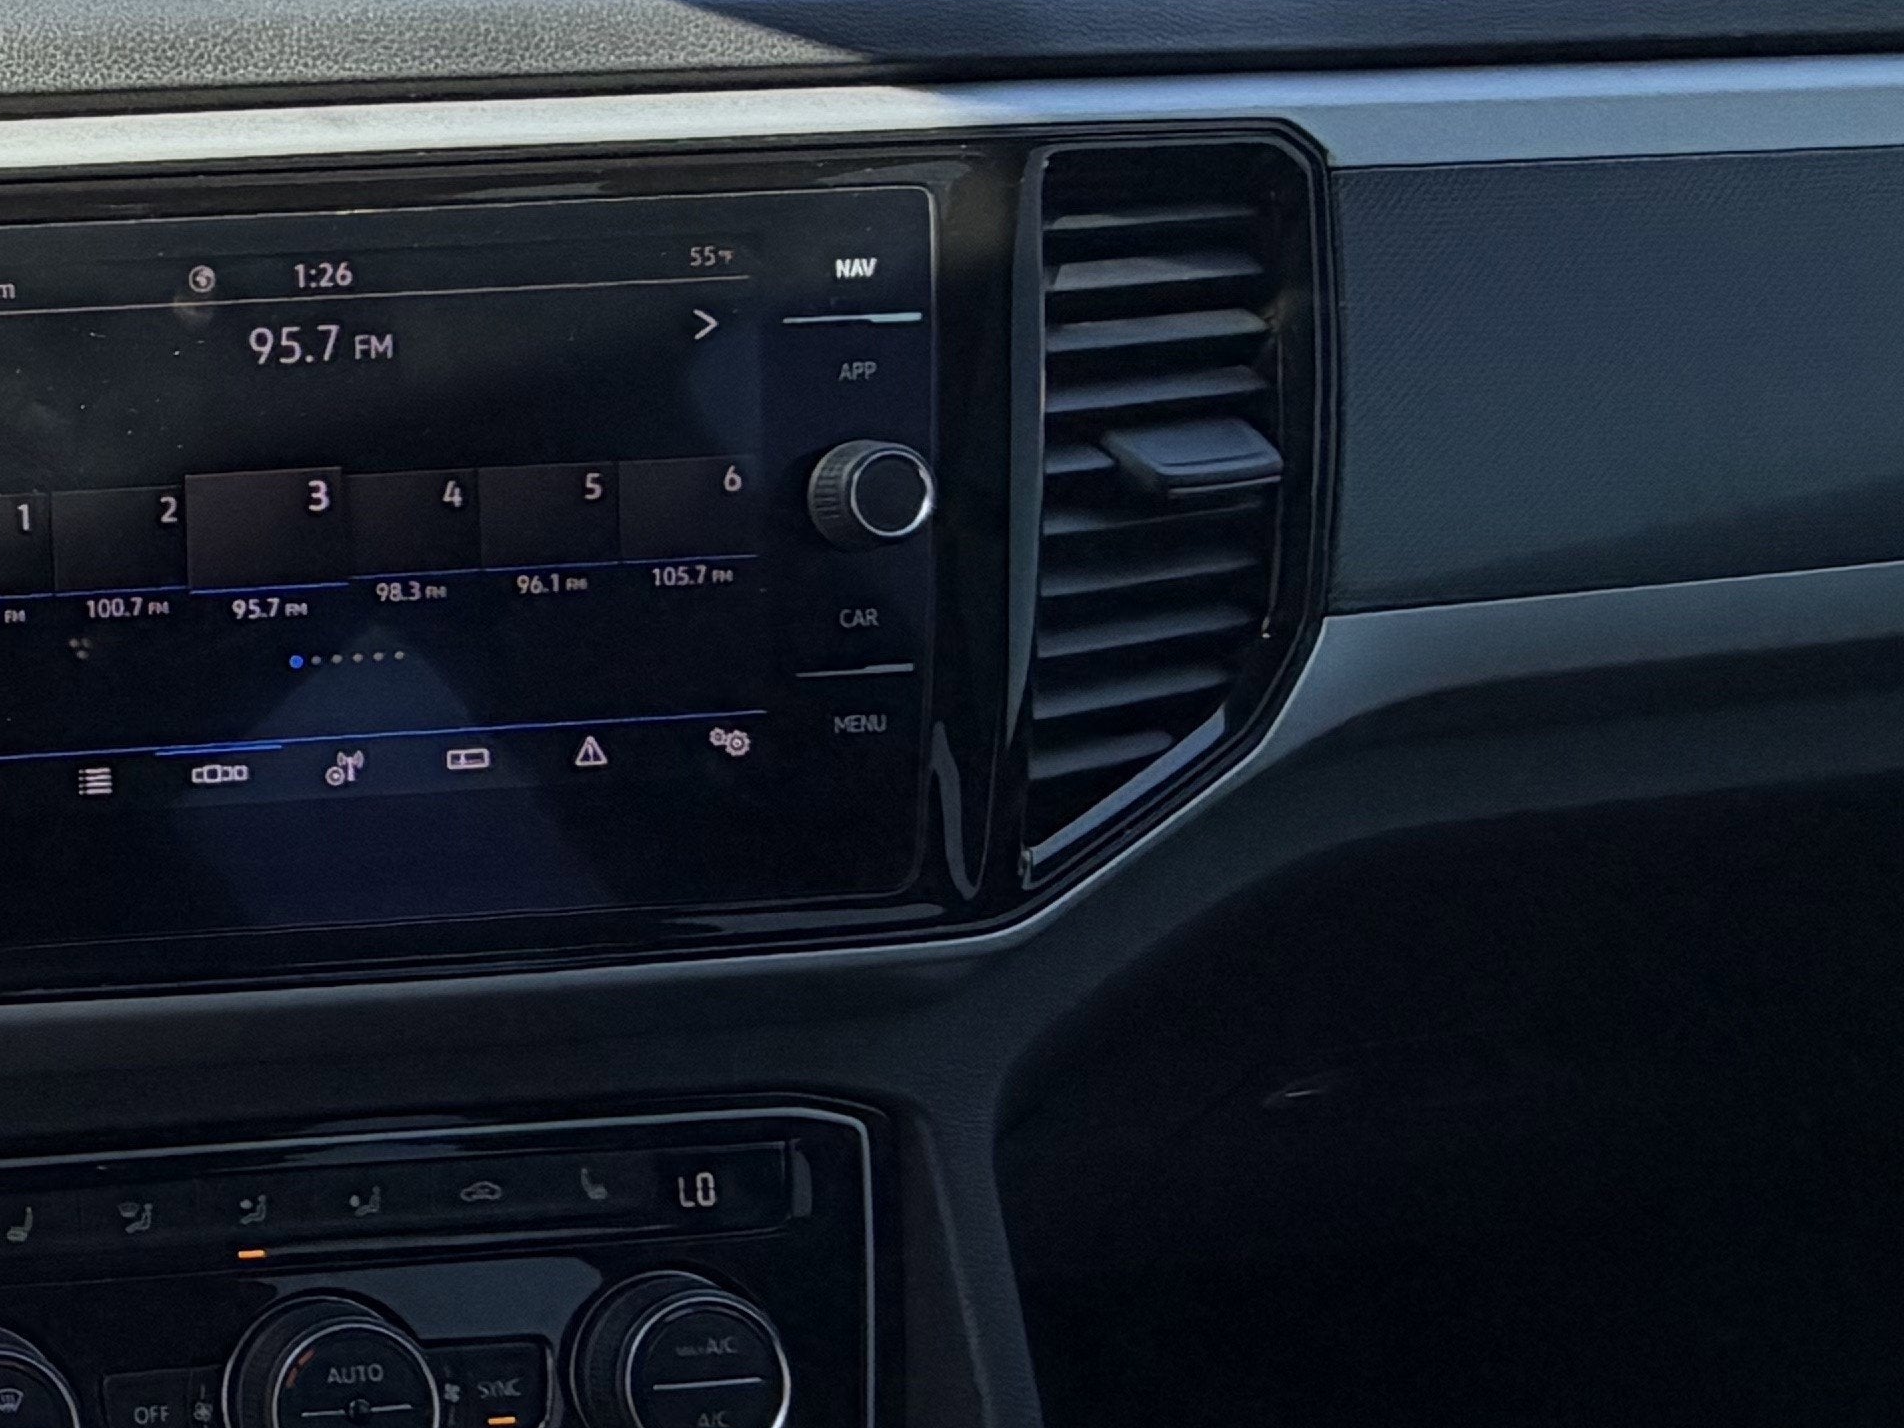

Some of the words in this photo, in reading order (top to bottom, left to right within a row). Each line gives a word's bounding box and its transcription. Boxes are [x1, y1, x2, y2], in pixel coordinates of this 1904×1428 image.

[293, 262, 354, 289] 1:26
[834, 258, 878, 280] NAV
[249, 324, 342, 365] 95.7
[354, 334, 394, 360] FM
[838, 361, 878, 382] APP
[583, 473, 603, 501] 5
[723, 464, 743, 493] 6
[307, 479, 331, 512] 3
[441, 479, 463, 509] 4
[16, 503, 31, 531] 1
[159, 496, 179, 524] 2
[516, 574, 562, 595] 96.1
[651, 565, 708, 587] 105.7
[376, 582, 423, 602] 98.3
[86, 597, 143, 619] 100.7
[231, 598, 281, 620] 95.7
[839, 607, 881, 629] CAR
[833, 714, 889, 735] MENU
[676, 1171, 718, 1210] LO
[704, 1335, 740, 1357] A/C
[326, 1363, 385, 1385] AUTO
[476, 1377, 523, 1400] SYNC
[133, 1404, 172, 1427] OFF
